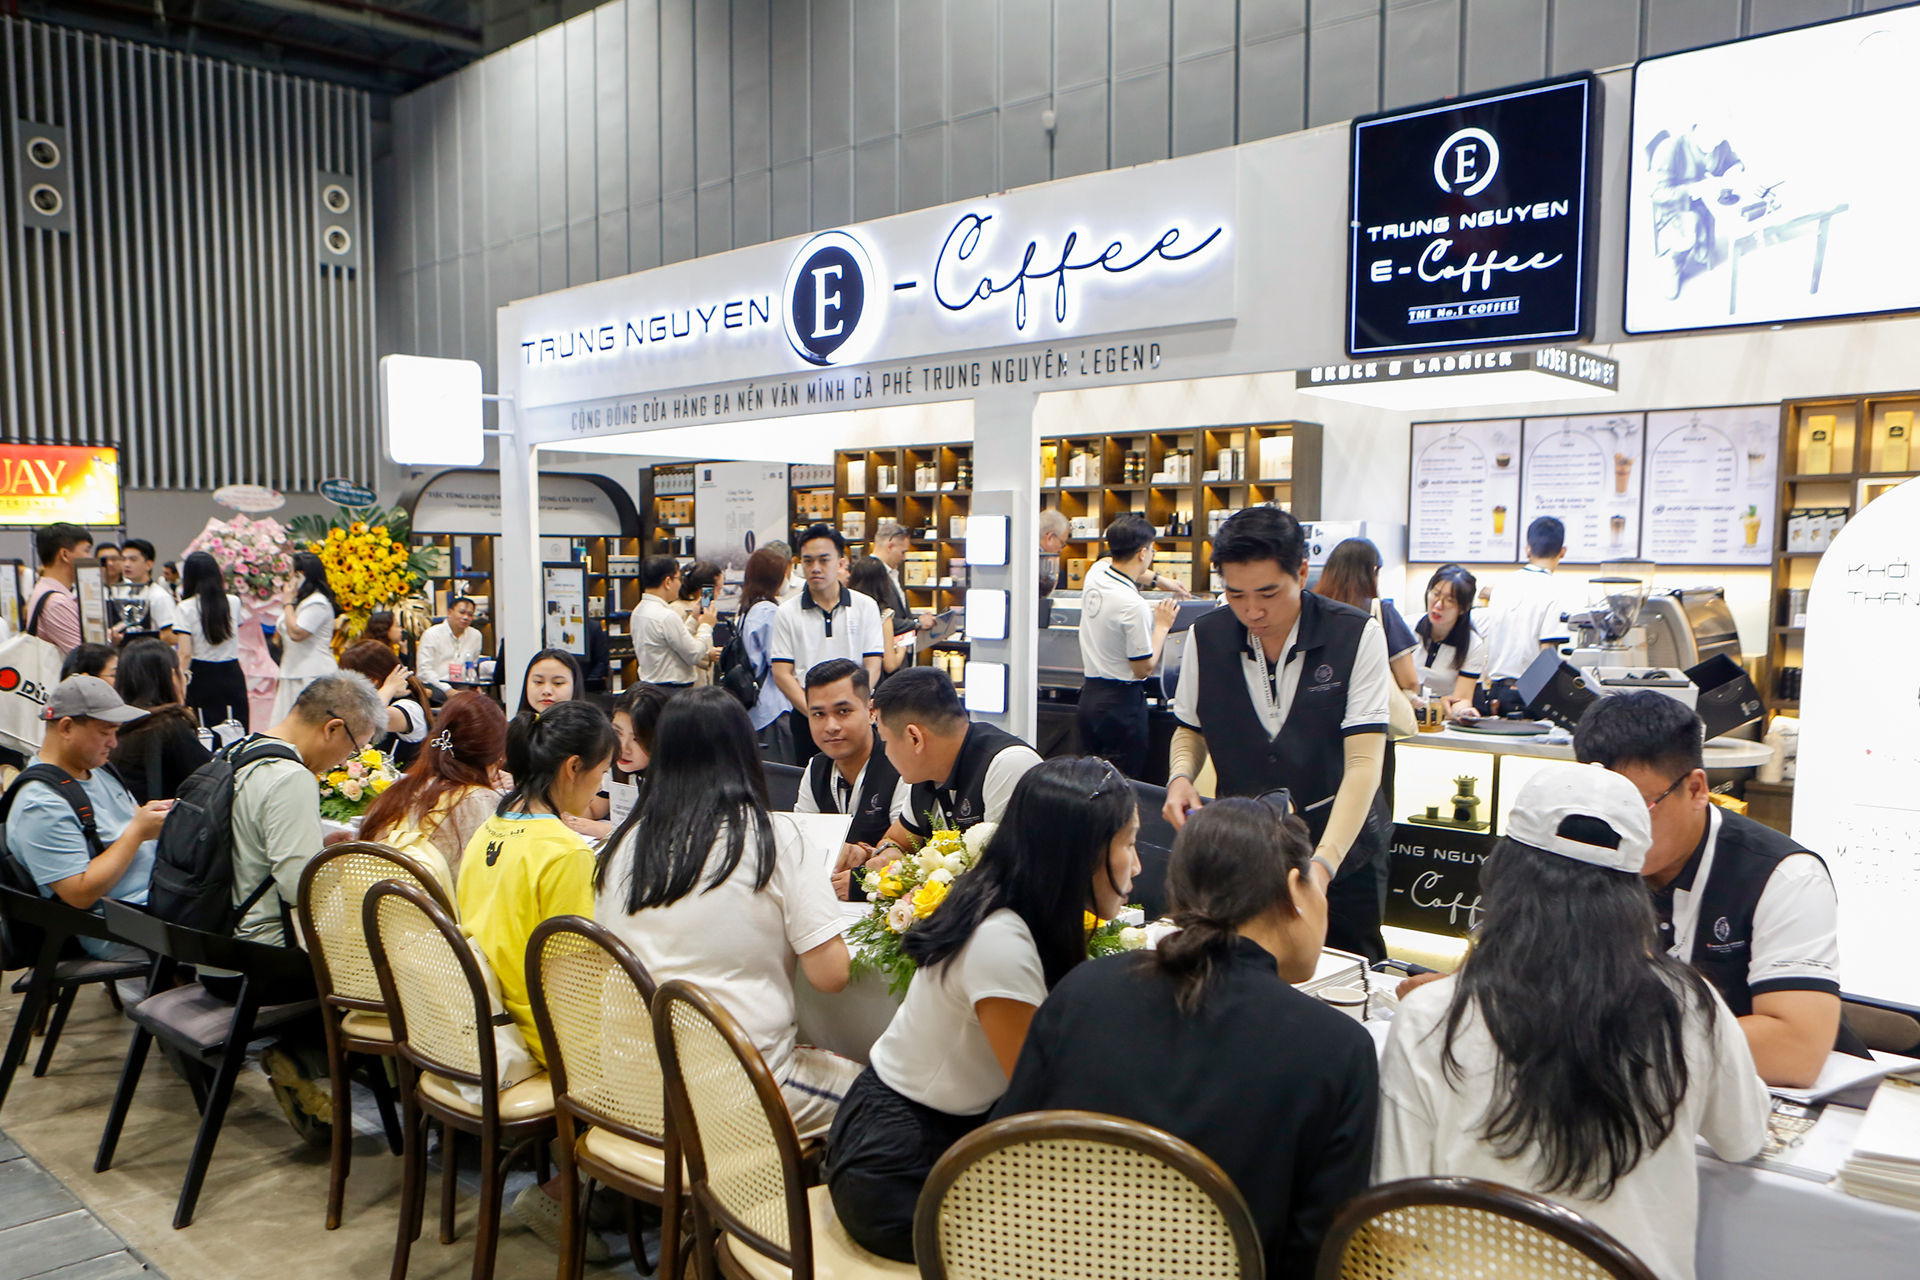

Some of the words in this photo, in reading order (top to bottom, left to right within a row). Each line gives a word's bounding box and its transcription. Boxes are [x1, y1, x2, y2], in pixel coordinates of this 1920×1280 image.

[1454, 144, 1478, 185] E
[1366, 216, 1450, 242] TRUNG
[1460, 199, 1569, 231] NGUYEN
[521, 326, 615, 366] TRUNG
[626, 296, 770, 348] NGUYEN
[1408, 309, 1432, 321] THE
[1437, 305, 1464, 318] No.1
[673, 394, 707, 419] HÀNG
[714, 392, 730, 415] BA
[854, 371, 873, 399] CÀ
[883, 366, 913, 396] PHÊ
[923, 362, 980, 391] TRUNG
[991, 350, 1068, 384] NGUYÊN
[1081, 342, 1161, 375] LEGEND
[1388, 843, 1425, 857] UNG
[1433, 848, 1490, 866] NGUY
[1411, 870, 1487, 928] Coff
